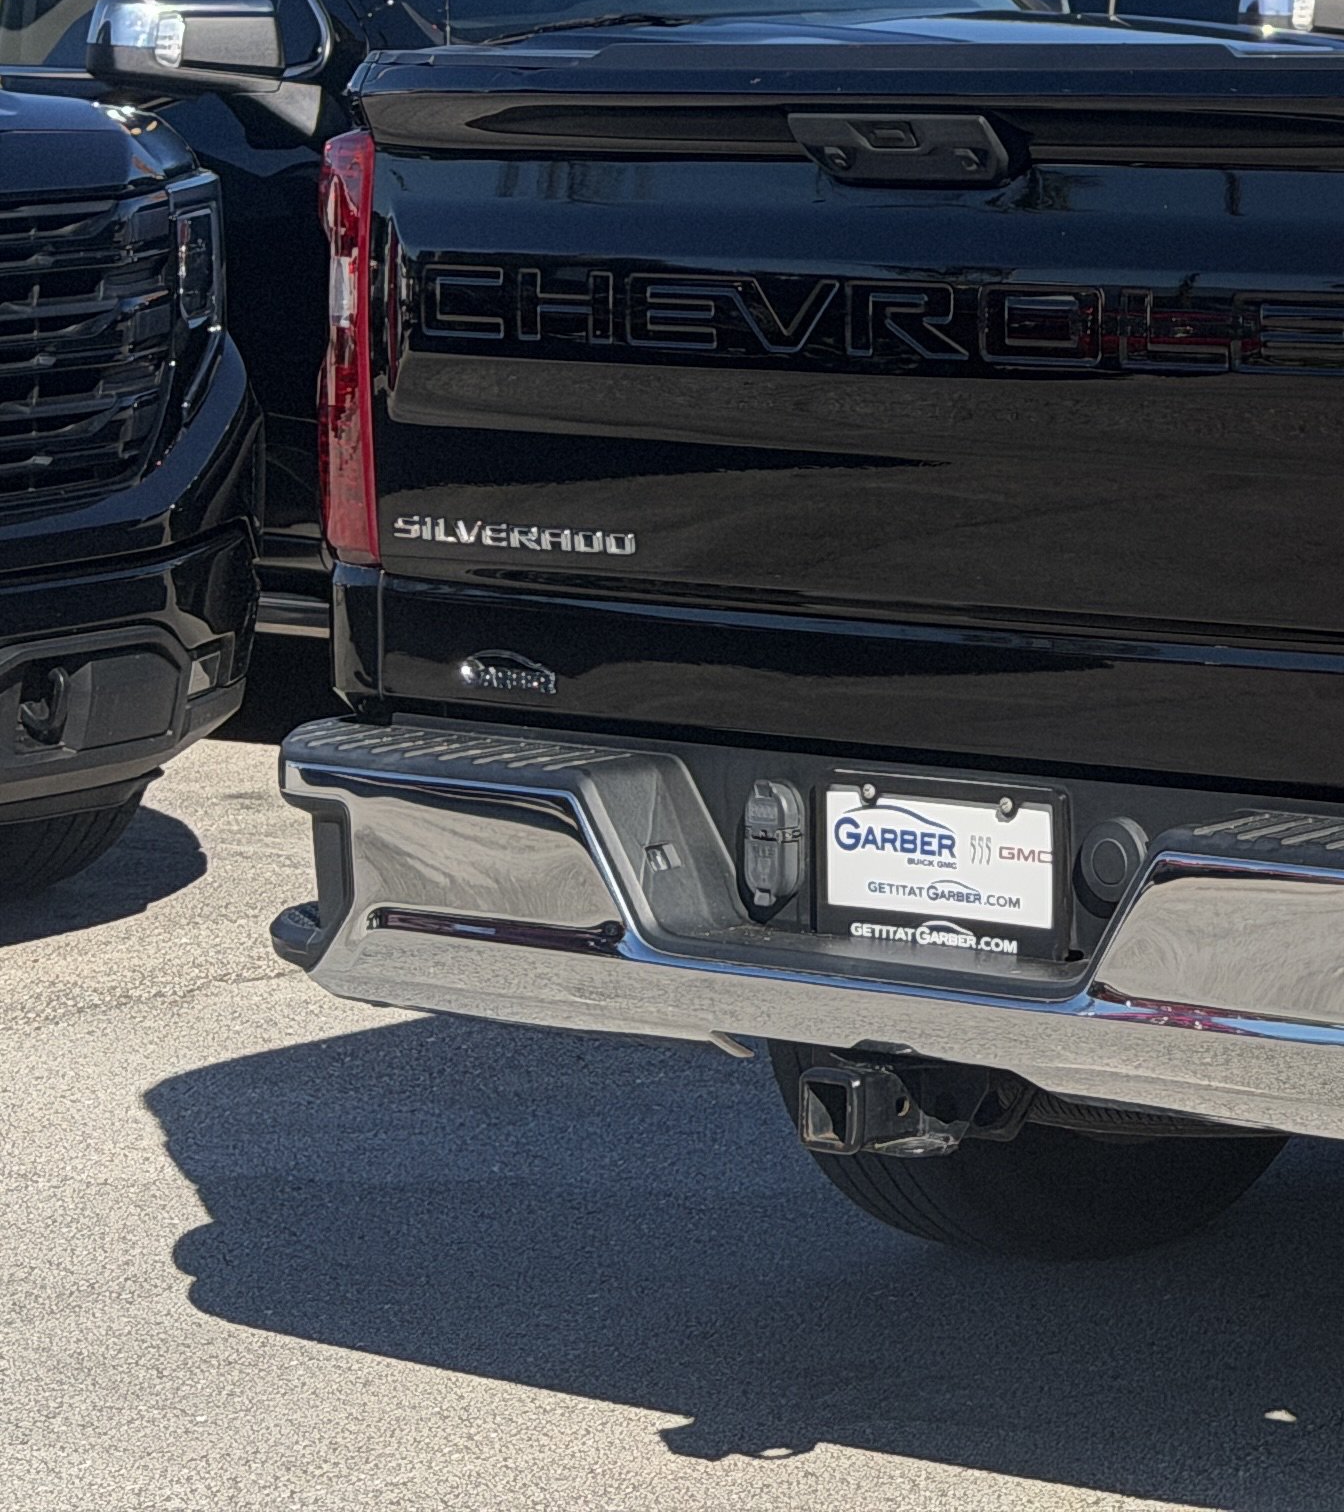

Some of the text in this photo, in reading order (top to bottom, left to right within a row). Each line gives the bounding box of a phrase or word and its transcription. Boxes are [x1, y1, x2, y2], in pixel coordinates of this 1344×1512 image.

[393, 514, 637, 556] SILVERADO
[833, 816, 957, 859] GARBER
[906, 857, 958, 870] BUICK GMC
[998, 846, 1053, 864] GMC
